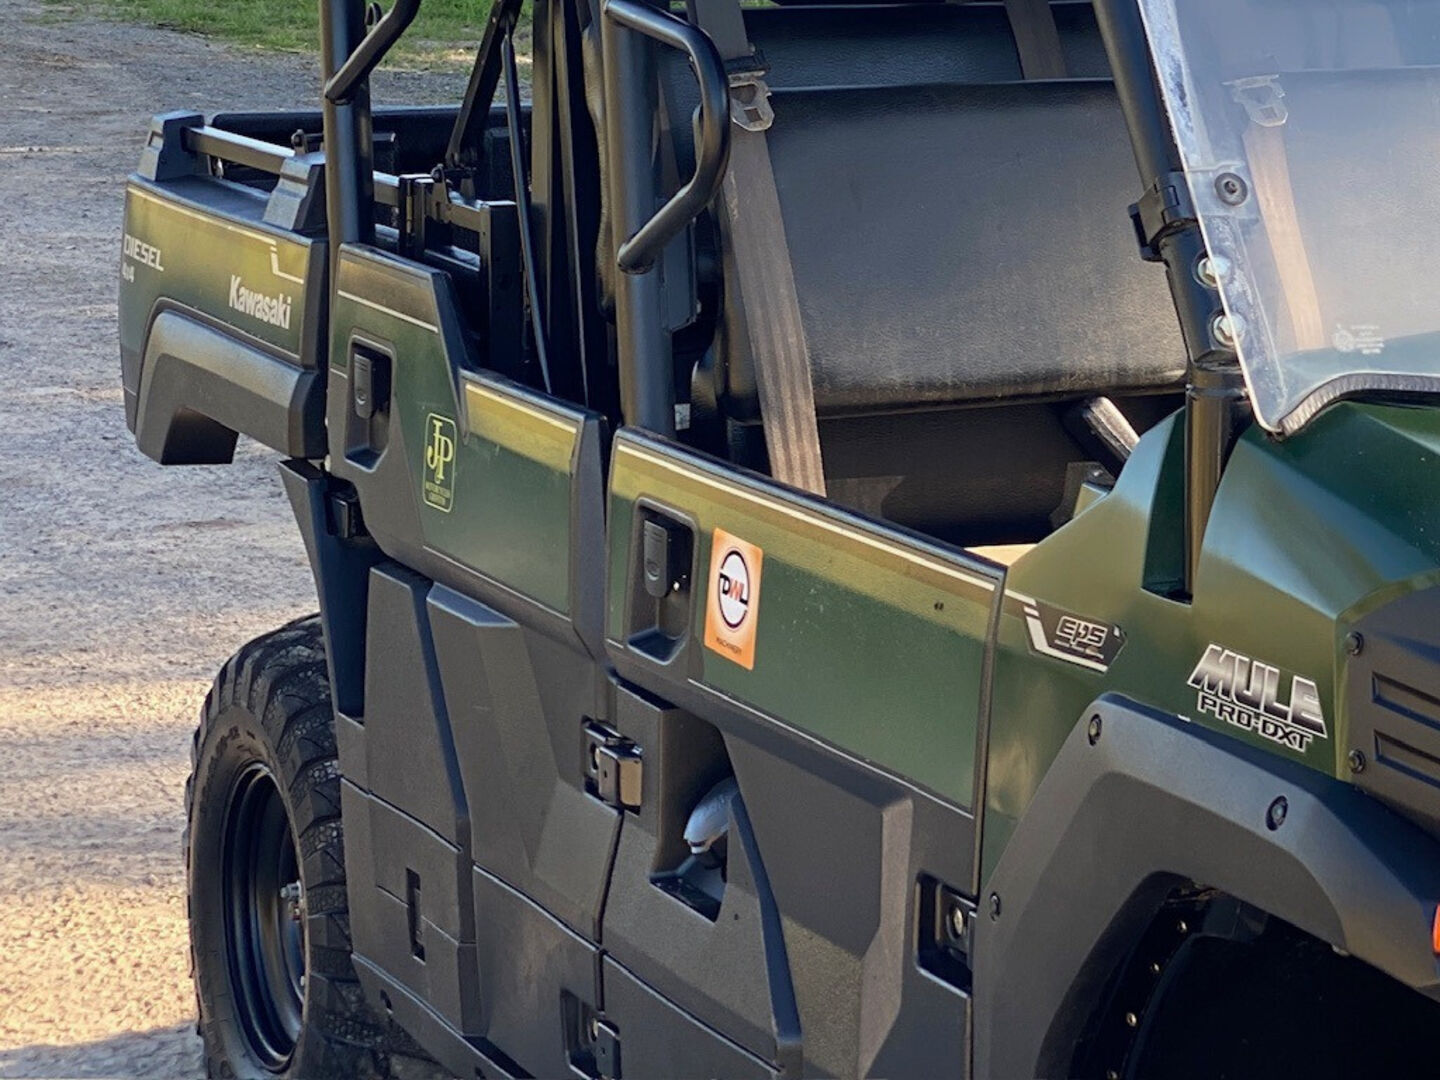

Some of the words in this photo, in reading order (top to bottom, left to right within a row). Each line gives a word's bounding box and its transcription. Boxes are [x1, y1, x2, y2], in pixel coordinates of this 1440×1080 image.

[124, 233, 164, 271] DIESEL
[229, 274, 292, 329] Kawasaki
[1055, 615, 1108, 647] EPS
[1187, 643, 1328, 739] MULE
[1196, 691, 1314, 754] PRO-DXT
